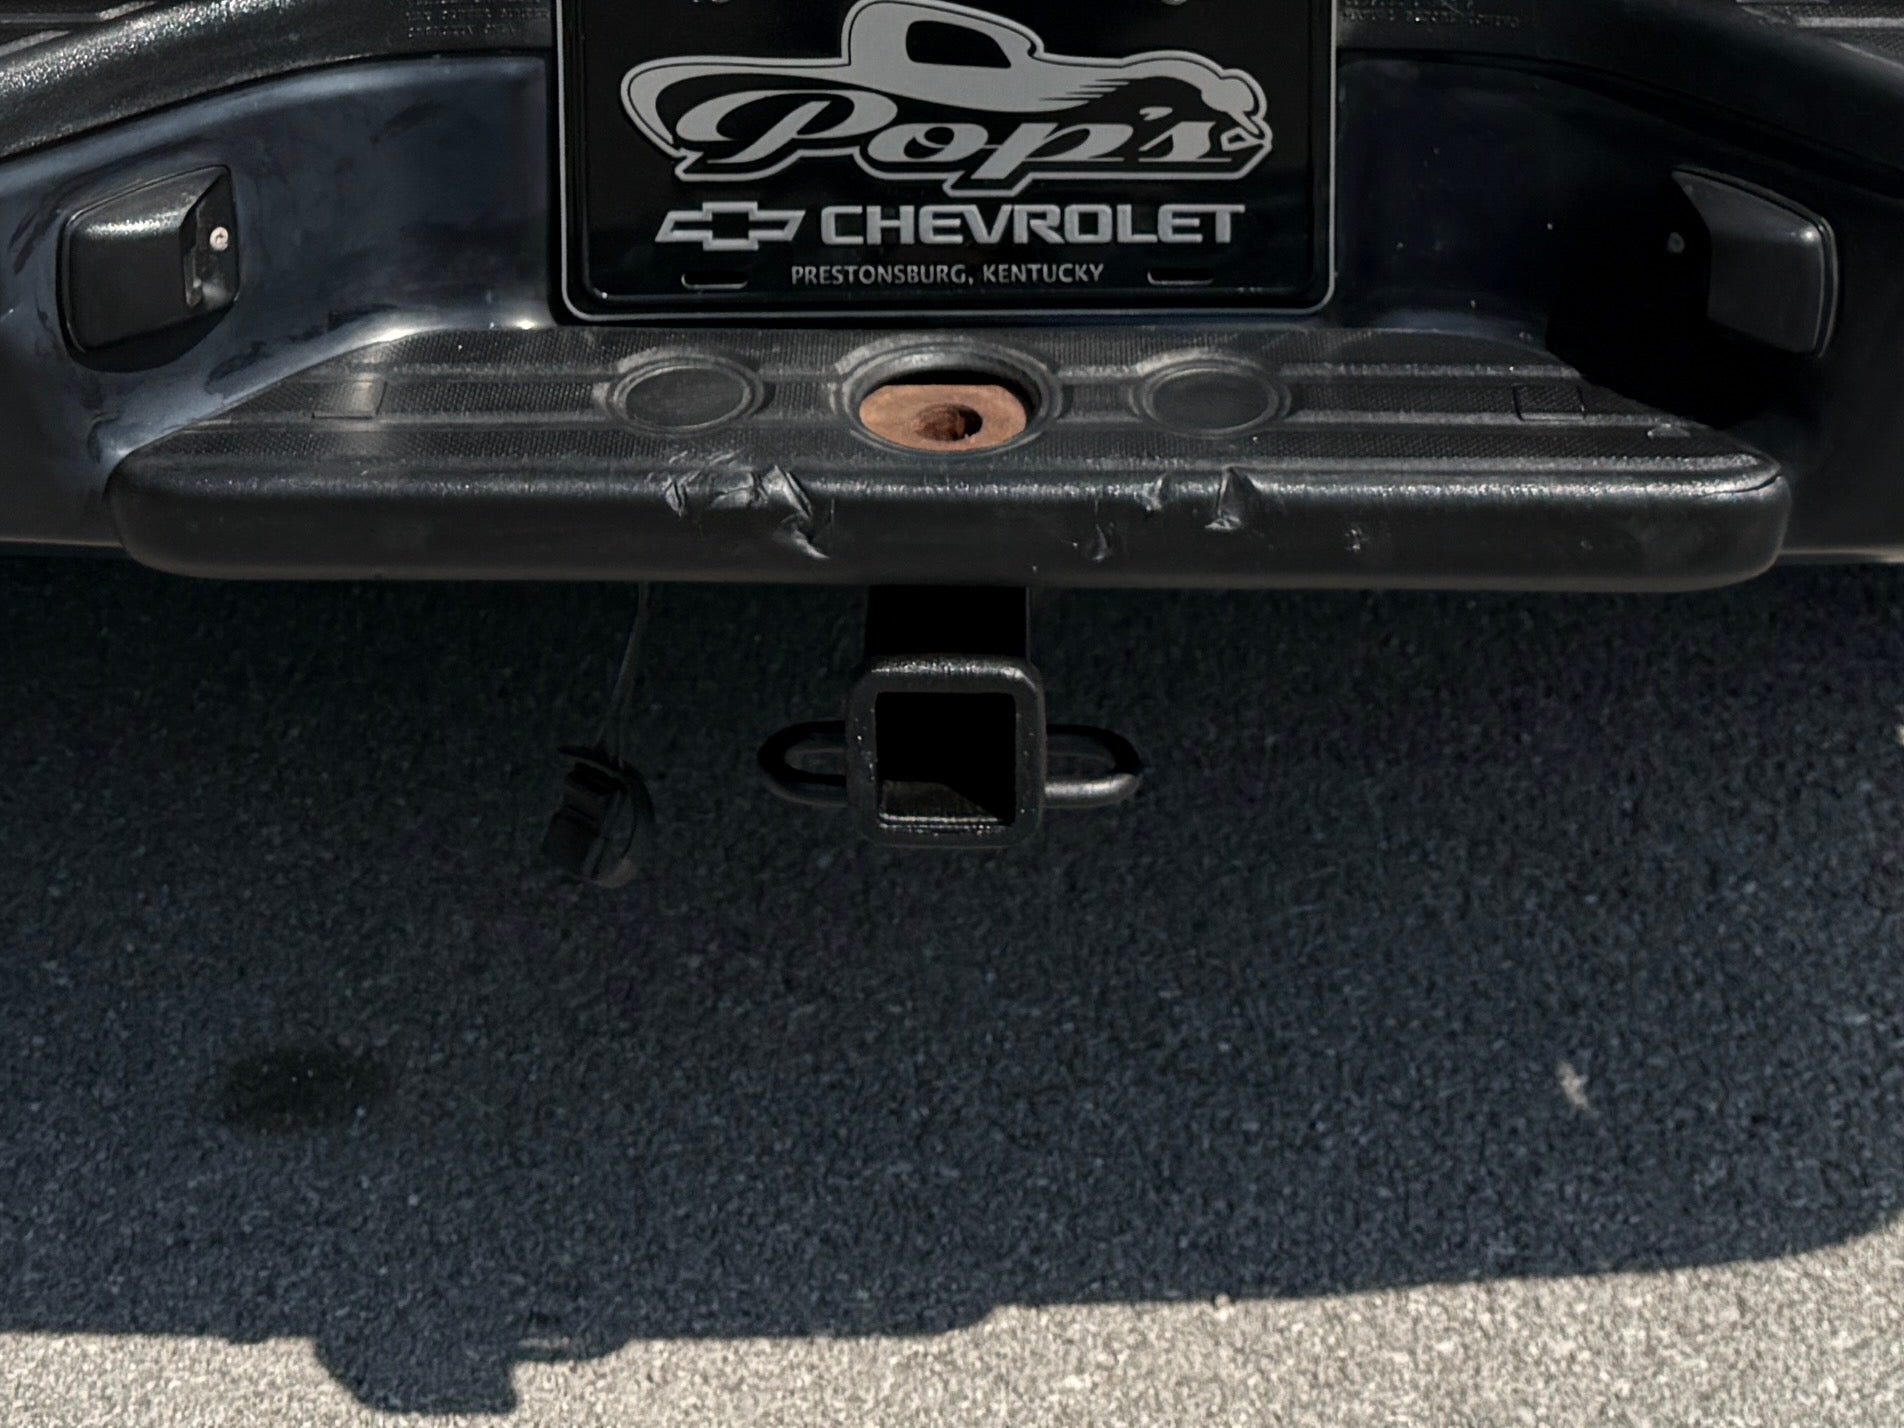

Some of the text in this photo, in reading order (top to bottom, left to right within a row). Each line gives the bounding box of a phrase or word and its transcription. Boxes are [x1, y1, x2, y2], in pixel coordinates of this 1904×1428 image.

[675, 89, 1233, 180] Pop's
[820, 202, 1246, 246] CHEVROLET
[790, 262, 1105, 287] PRESTONSBURG, KENTUCKY
